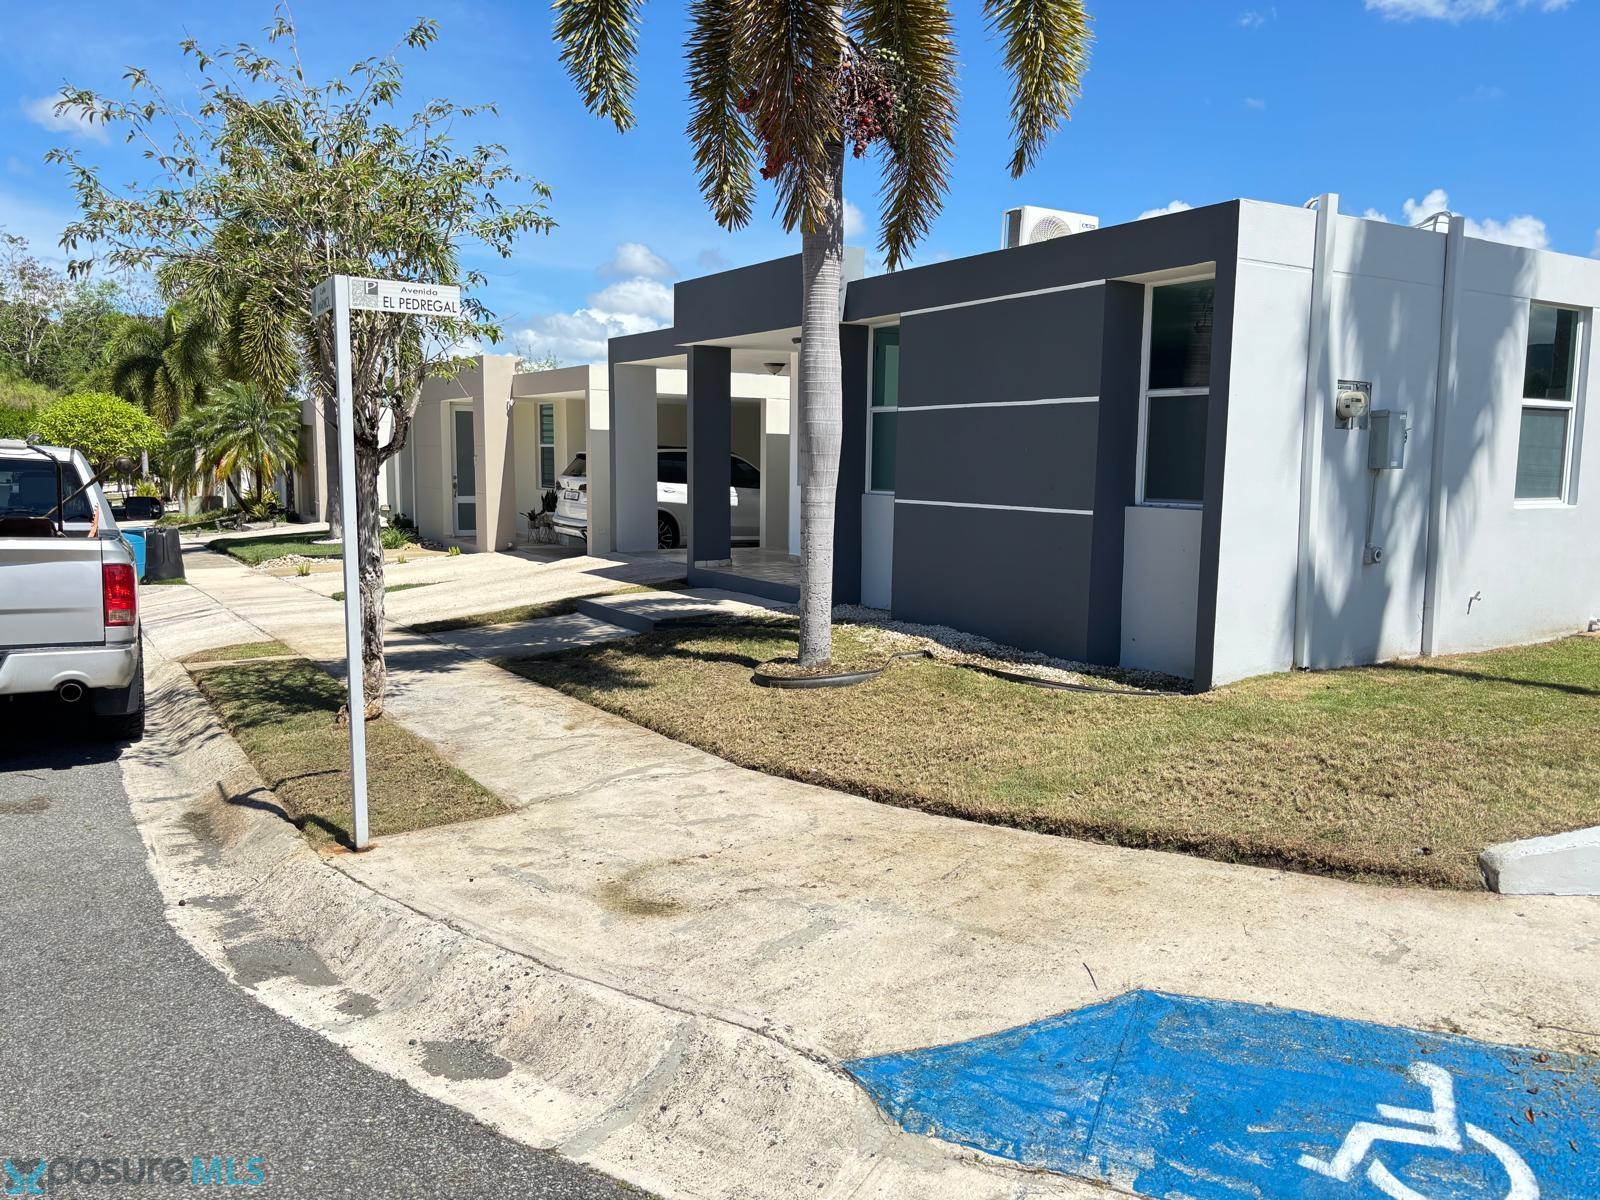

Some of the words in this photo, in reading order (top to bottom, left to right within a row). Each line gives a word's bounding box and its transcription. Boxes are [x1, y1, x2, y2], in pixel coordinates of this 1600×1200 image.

[401, 286, 438, 296] Avenida
[383, 296, 395, 309] EL
[399, 297, 457, 313] PEDREGAL
